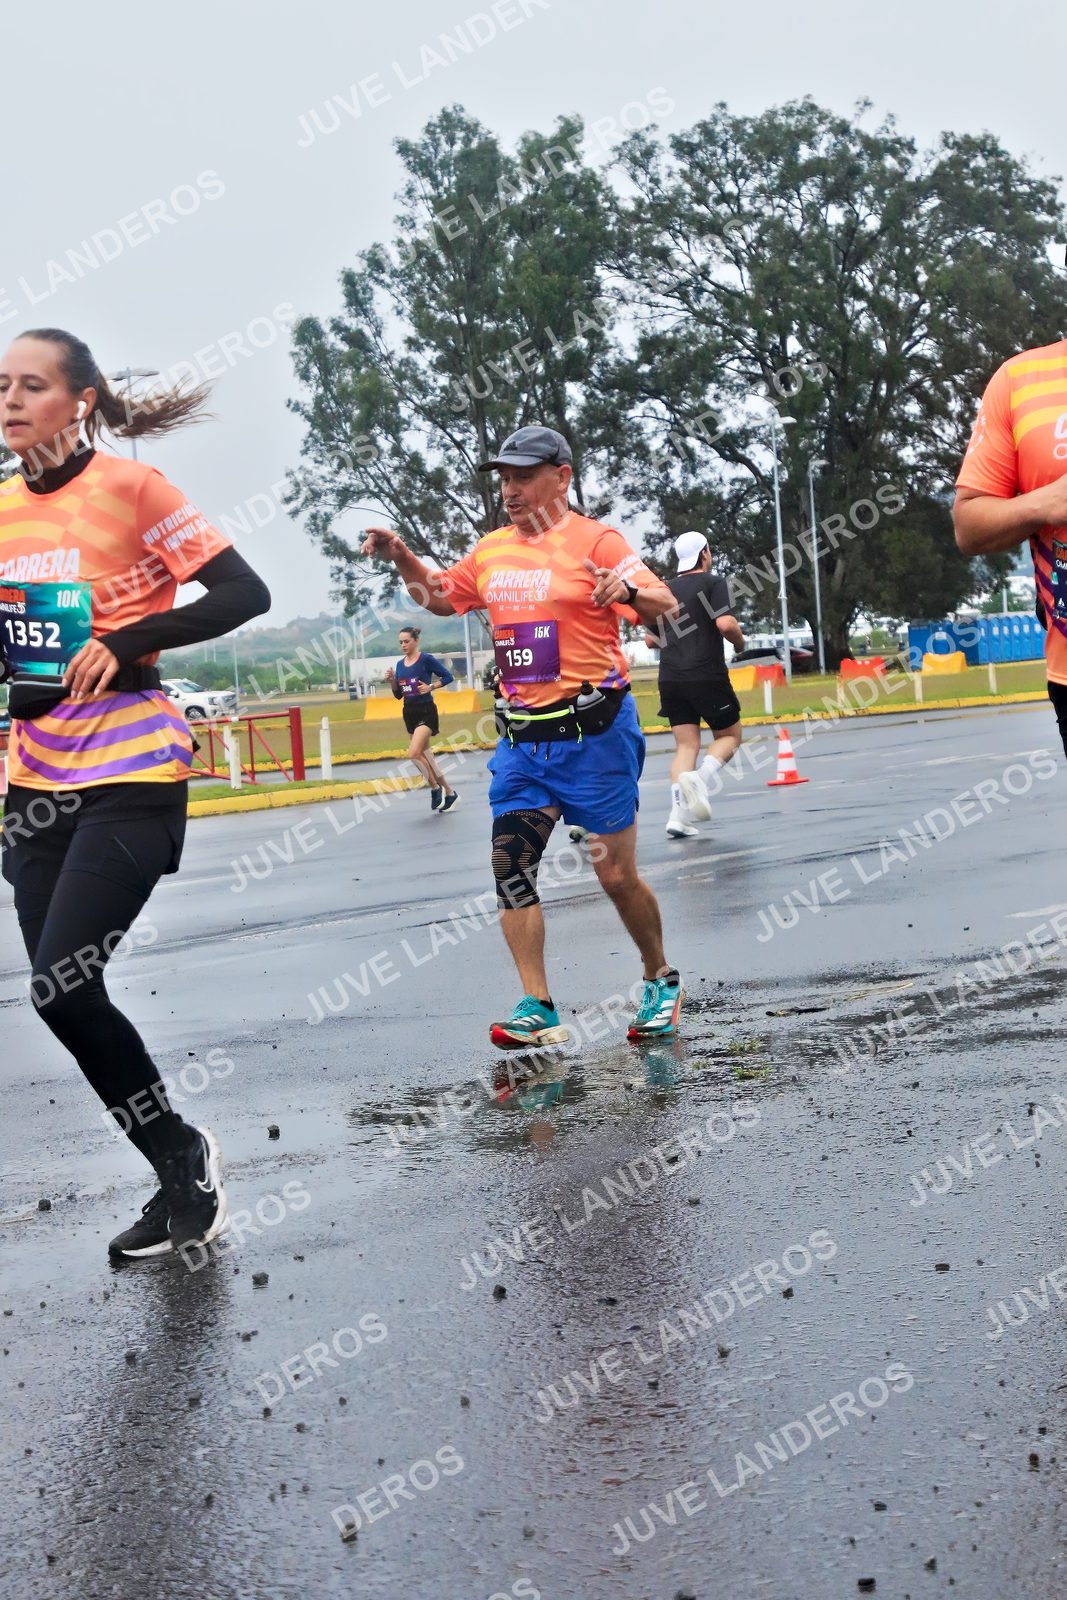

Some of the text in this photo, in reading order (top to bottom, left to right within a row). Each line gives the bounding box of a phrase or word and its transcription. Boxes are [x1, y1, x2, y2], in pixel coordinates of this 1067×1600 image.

[488, 569, 551, 589] CARRERA
[57, 589, 80, 608] 10K
[5, 619, 61, 648] 1352
[506, 648, 533, 667] 159
